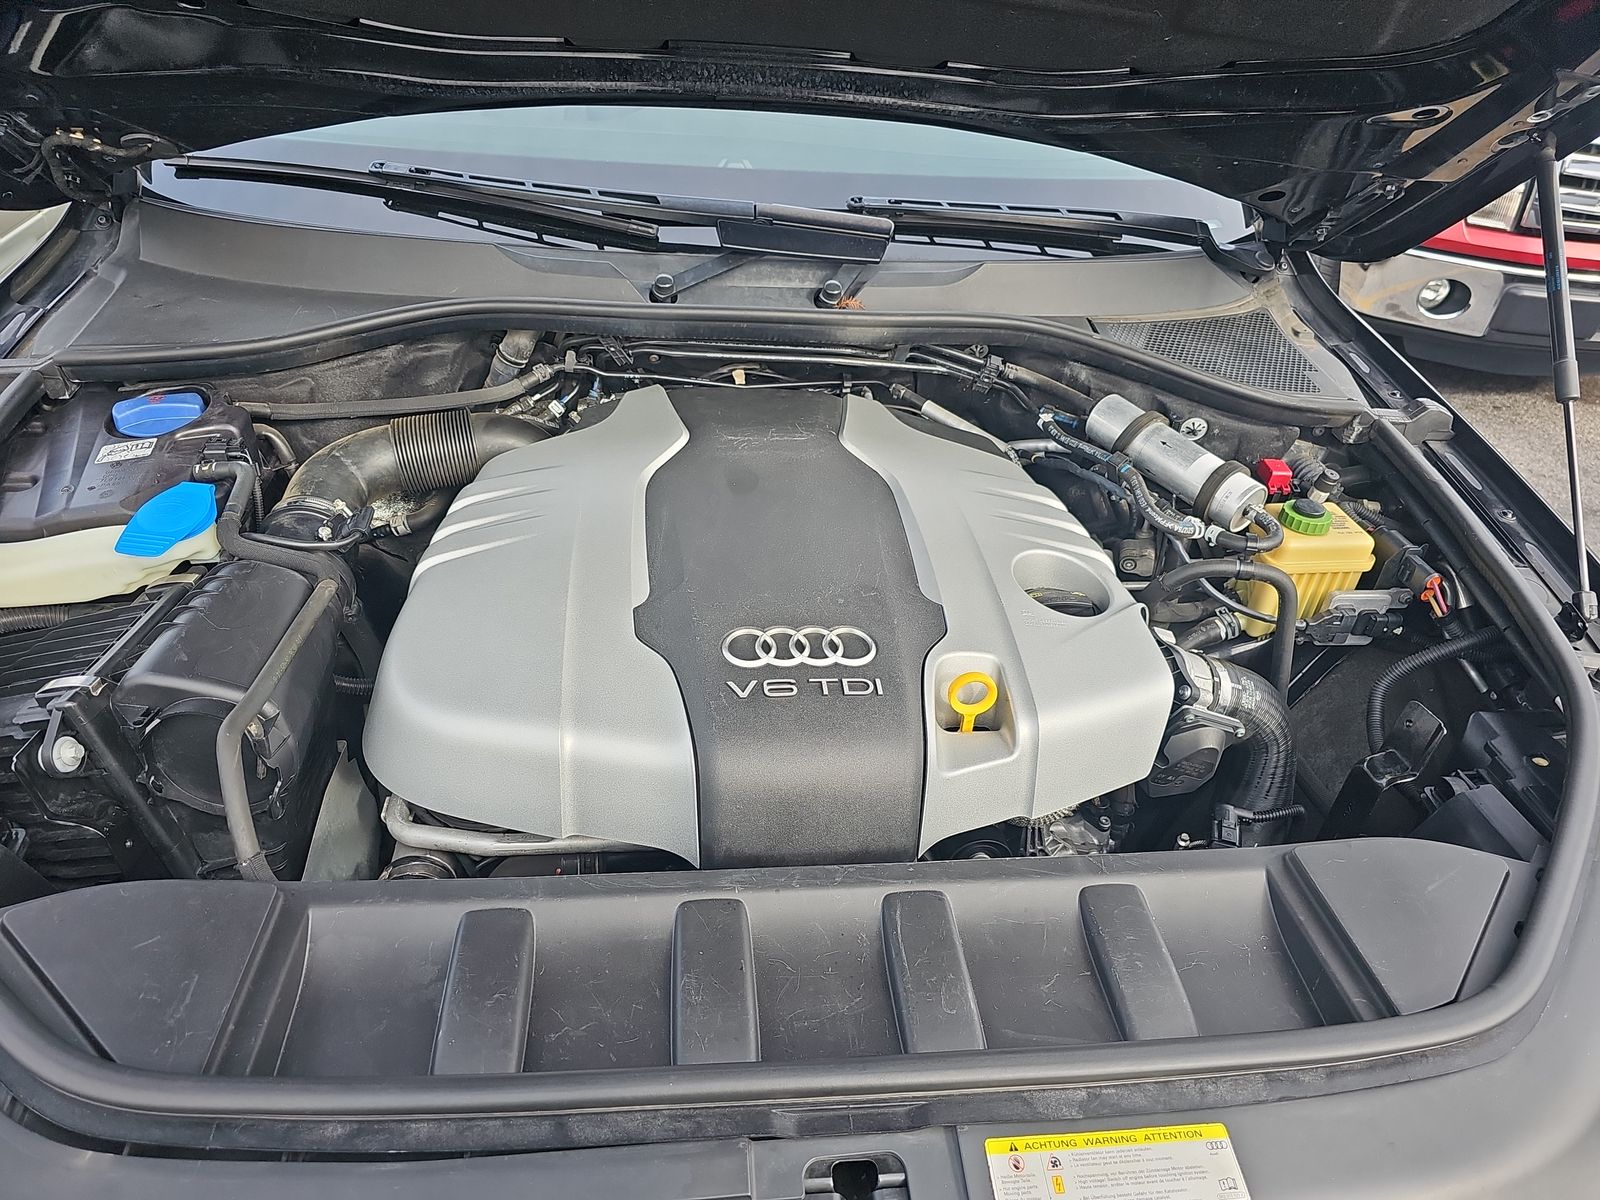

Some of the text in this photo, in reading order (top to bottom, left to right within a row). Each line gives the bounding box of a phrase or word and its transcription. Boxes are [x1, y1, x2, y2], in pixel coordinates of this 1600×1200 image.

[726, 678, 884, 699] V6 TDI
[1024, 1129, 1203, 1150] ACHTUNG WARNING ATTENTION
